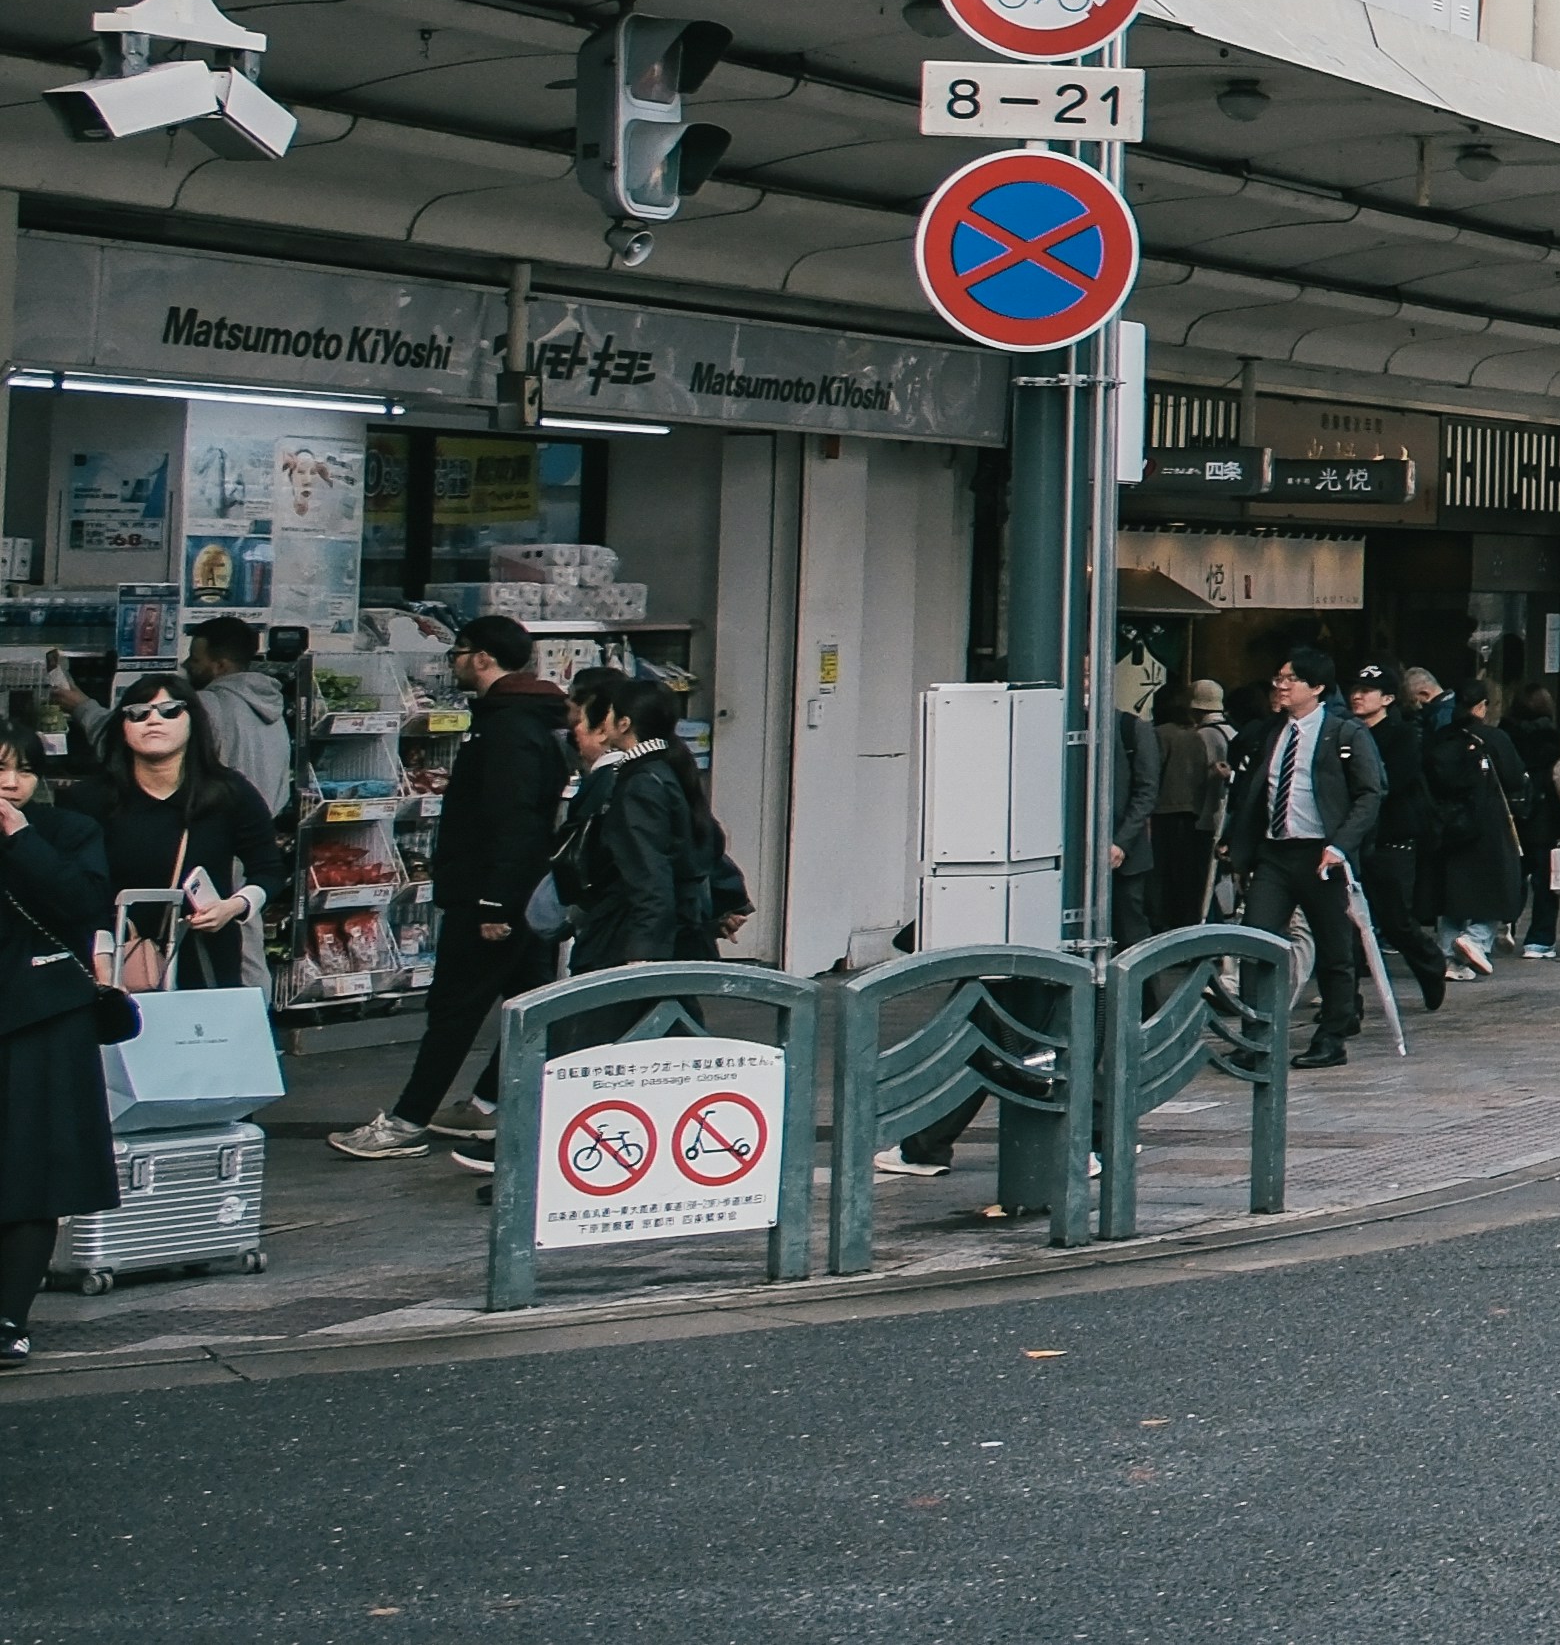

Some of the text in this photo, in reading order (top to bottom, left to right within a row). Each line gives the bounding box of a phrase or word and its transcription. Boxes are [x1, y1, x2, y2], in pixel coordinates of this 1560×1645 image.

[162, 305, 343, 361] Matsumoto
[689, 362, 816, 405] Matsumoto
[1205, 461, 1242, 481] 四条
[1314, 467, 1372, 491] 光悦
[592, 1071, 738, 1090] Bicycle passage closure
